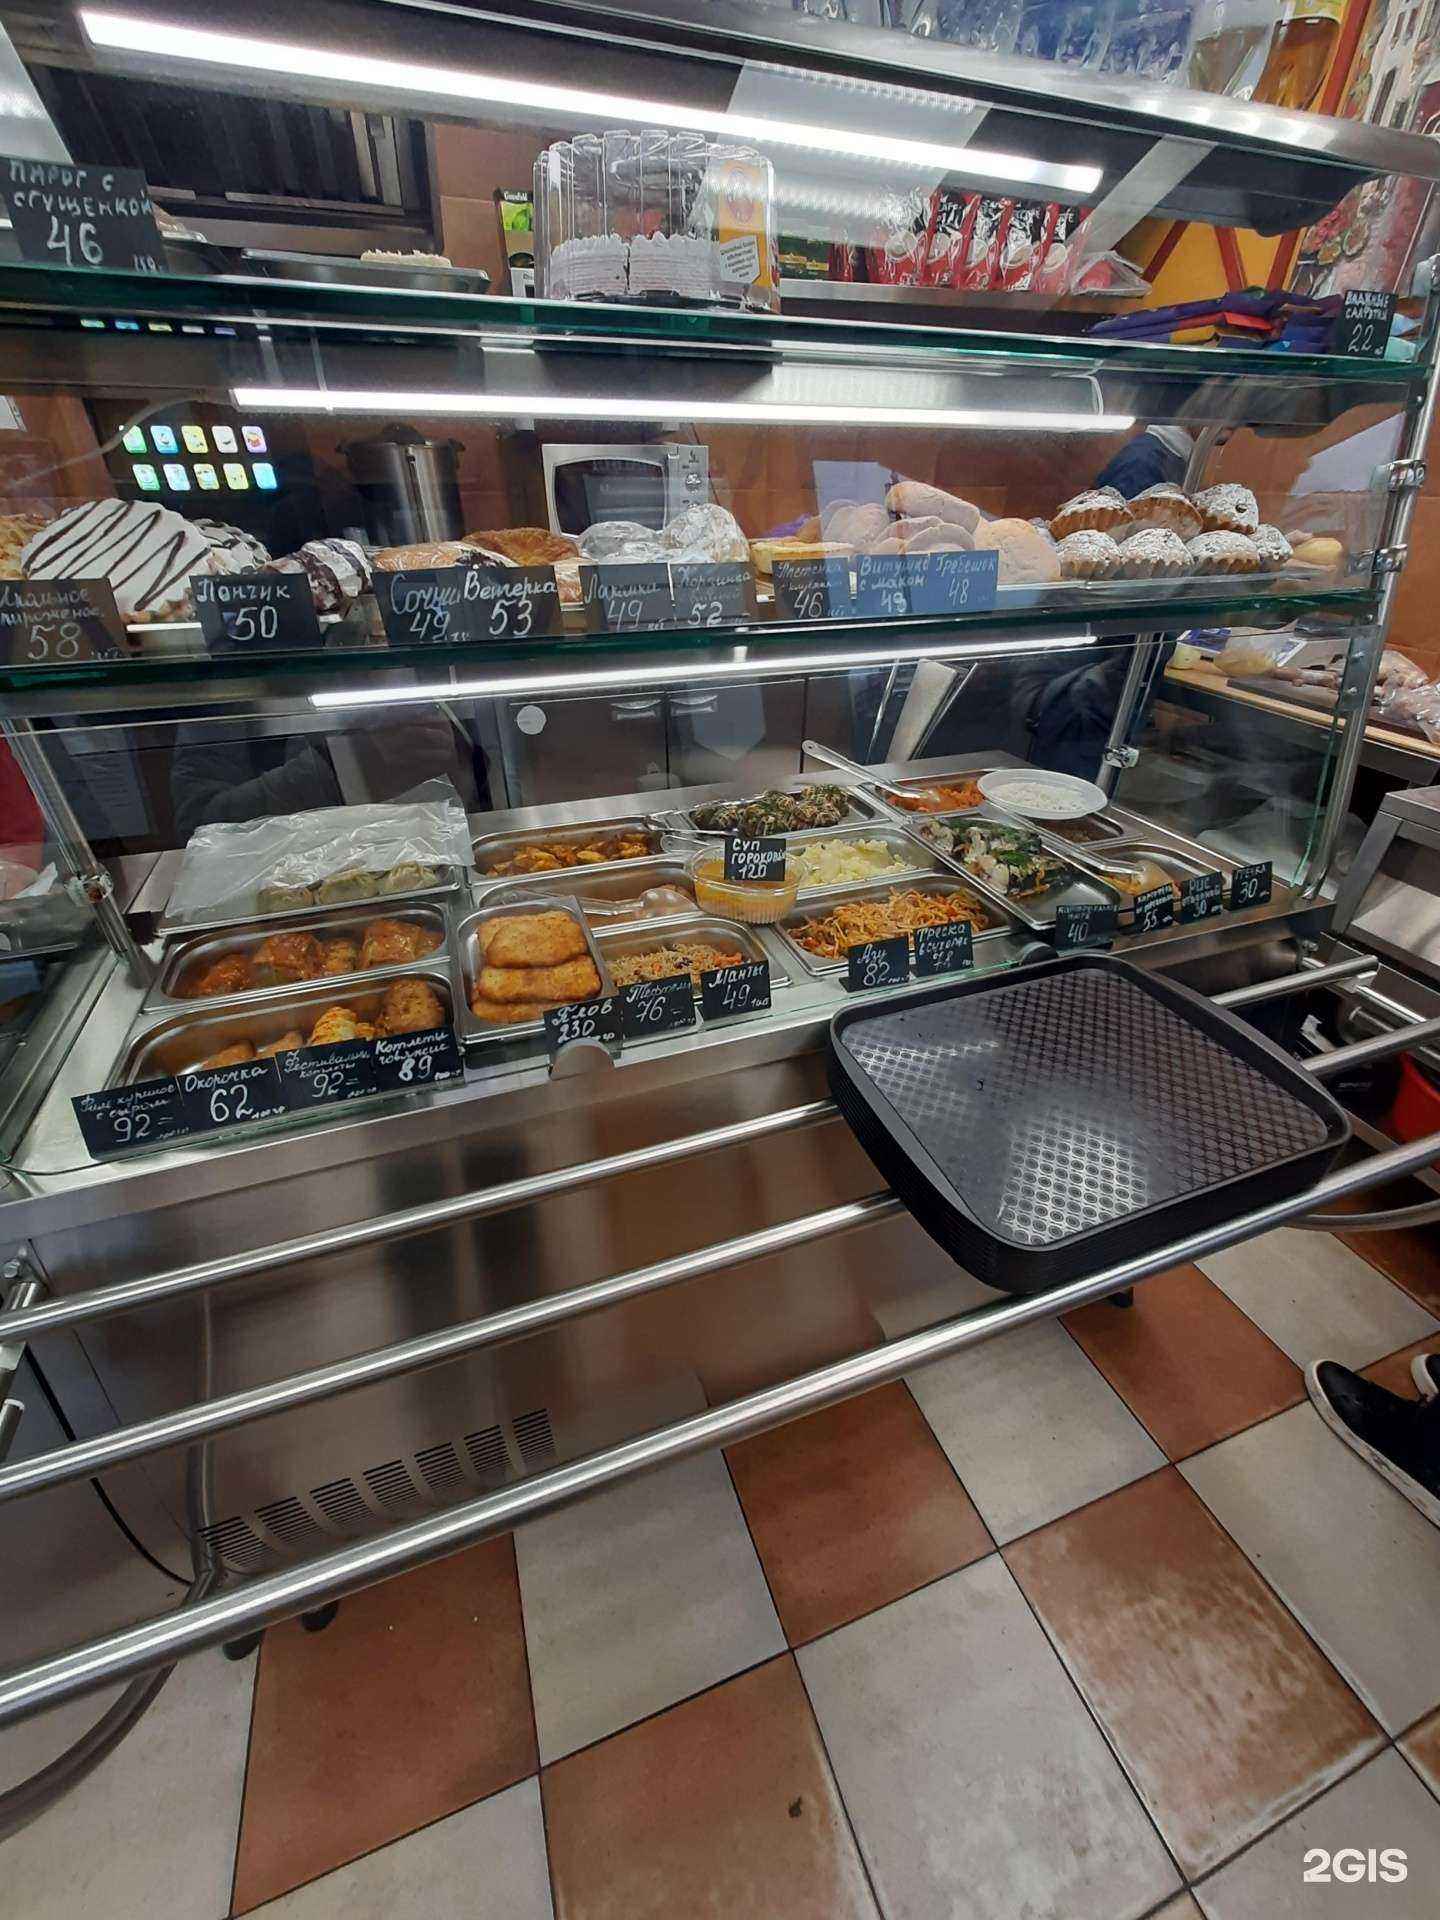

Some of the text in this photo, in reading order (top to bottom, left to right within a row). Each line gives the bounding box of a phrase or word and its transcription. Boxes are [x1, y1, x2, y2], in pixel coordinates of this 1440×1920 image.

[47, 214, 103, 267] 46
[1347, 323, 1374, 352] 22
[196, 577, 291, 602] Пончик
[948, 577, 971, 607] 48
[489, 599, 533, 636] 53
[607, 599, 643, 633] 49
[687, 601, 723, 628] 52
[793, 590, 824, 619] 46
[227, 605, 278, 640] 50
[409, 610, 450, 640] 49
[28, 622, 81, 660] 58
[1238, 878, 1259, 904] 30
[1067, 921, 1089, 943] 40
[863, 961, 891, 987] 82
[635, 996, 666, 1023] 76
[722, 983, 751, 1009] 49
[557, 1019, 596, 1043] 230
[184, 1066, 268, 1093] Окорочка
[398, 1055, 433, 1081] 89
[311, 1071, 345, 1098] 92
[210, 1084, 253, 1122] 62
[113, 1113, 151, 1143] 92
